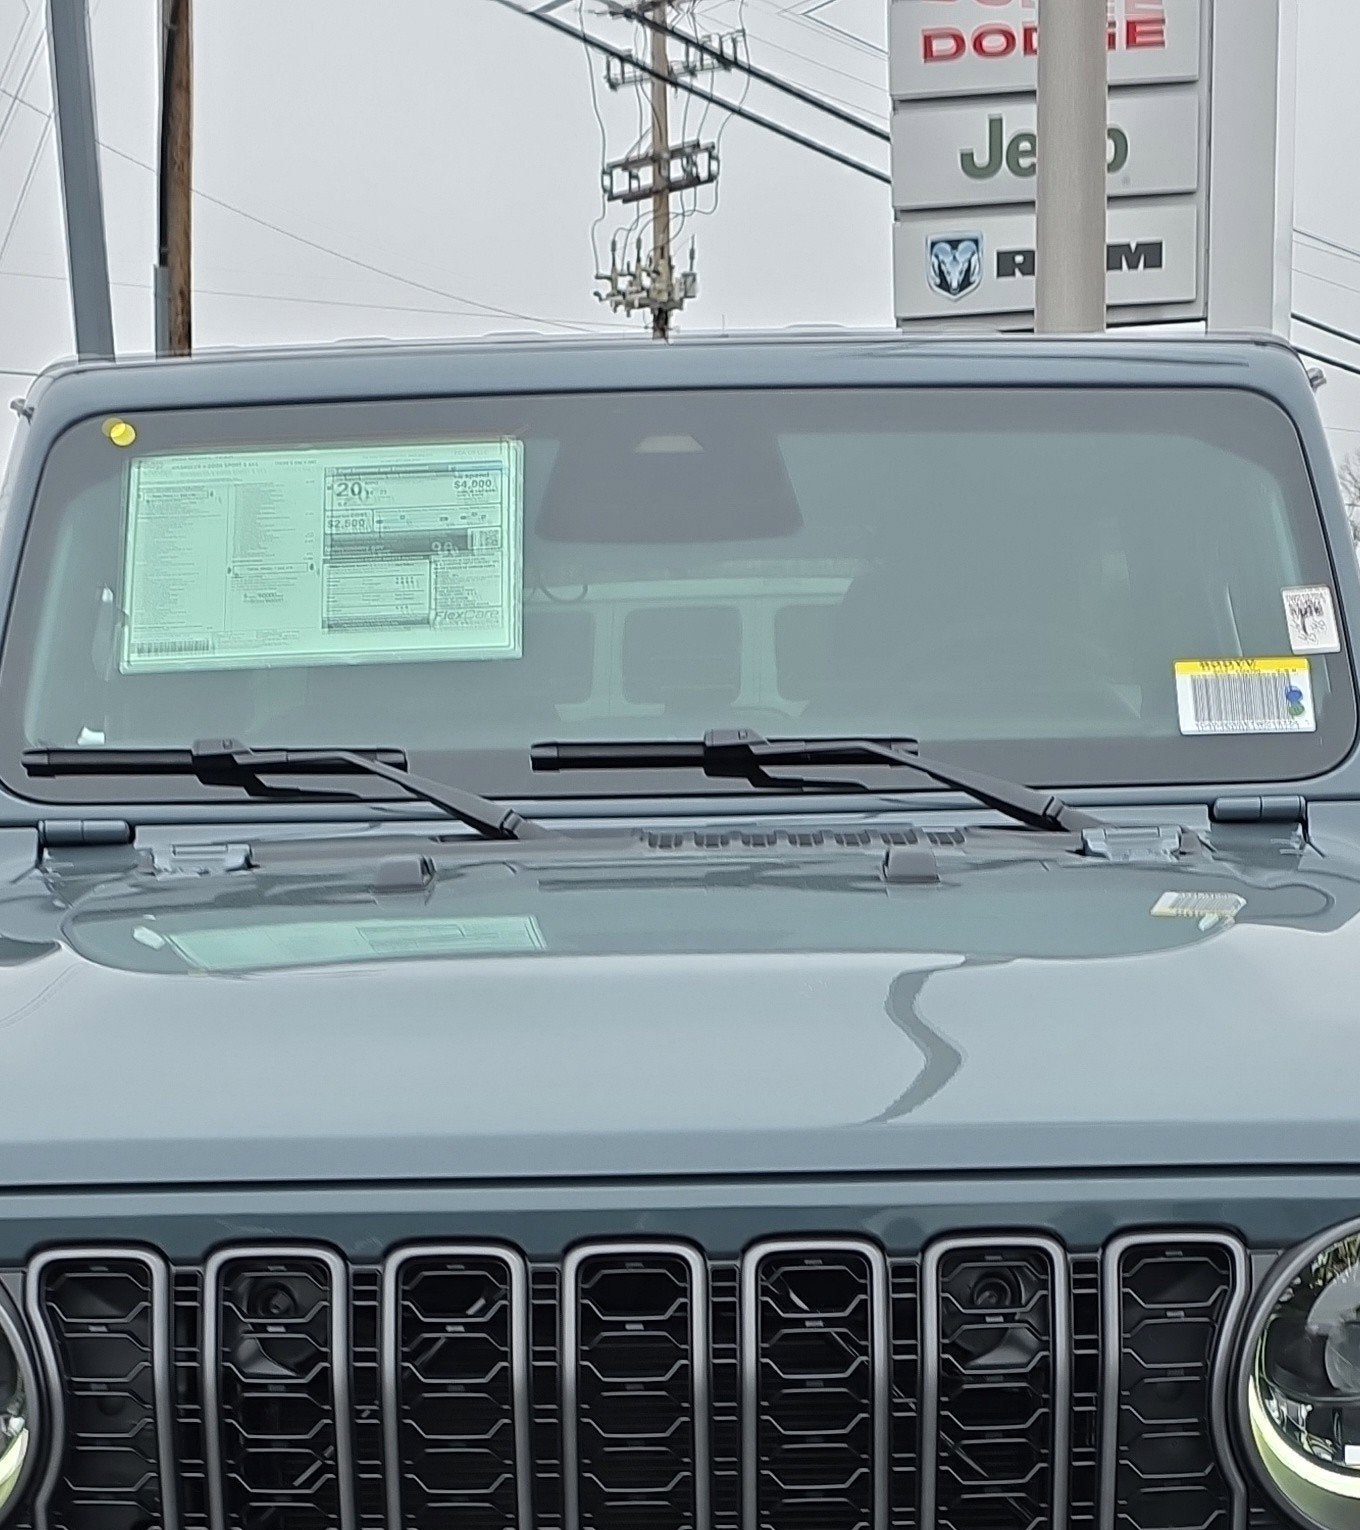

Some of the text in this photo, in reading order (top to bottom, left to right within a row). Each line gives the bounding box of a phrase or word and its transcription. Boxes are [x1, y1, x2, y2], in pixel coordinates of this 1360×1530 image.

[921, 17, 1167, 63] DOE
[959, 114, 1129, 181] Jep
[996, 241, 1163, 278] RM
[454, 479, 492, 490] $4,000
